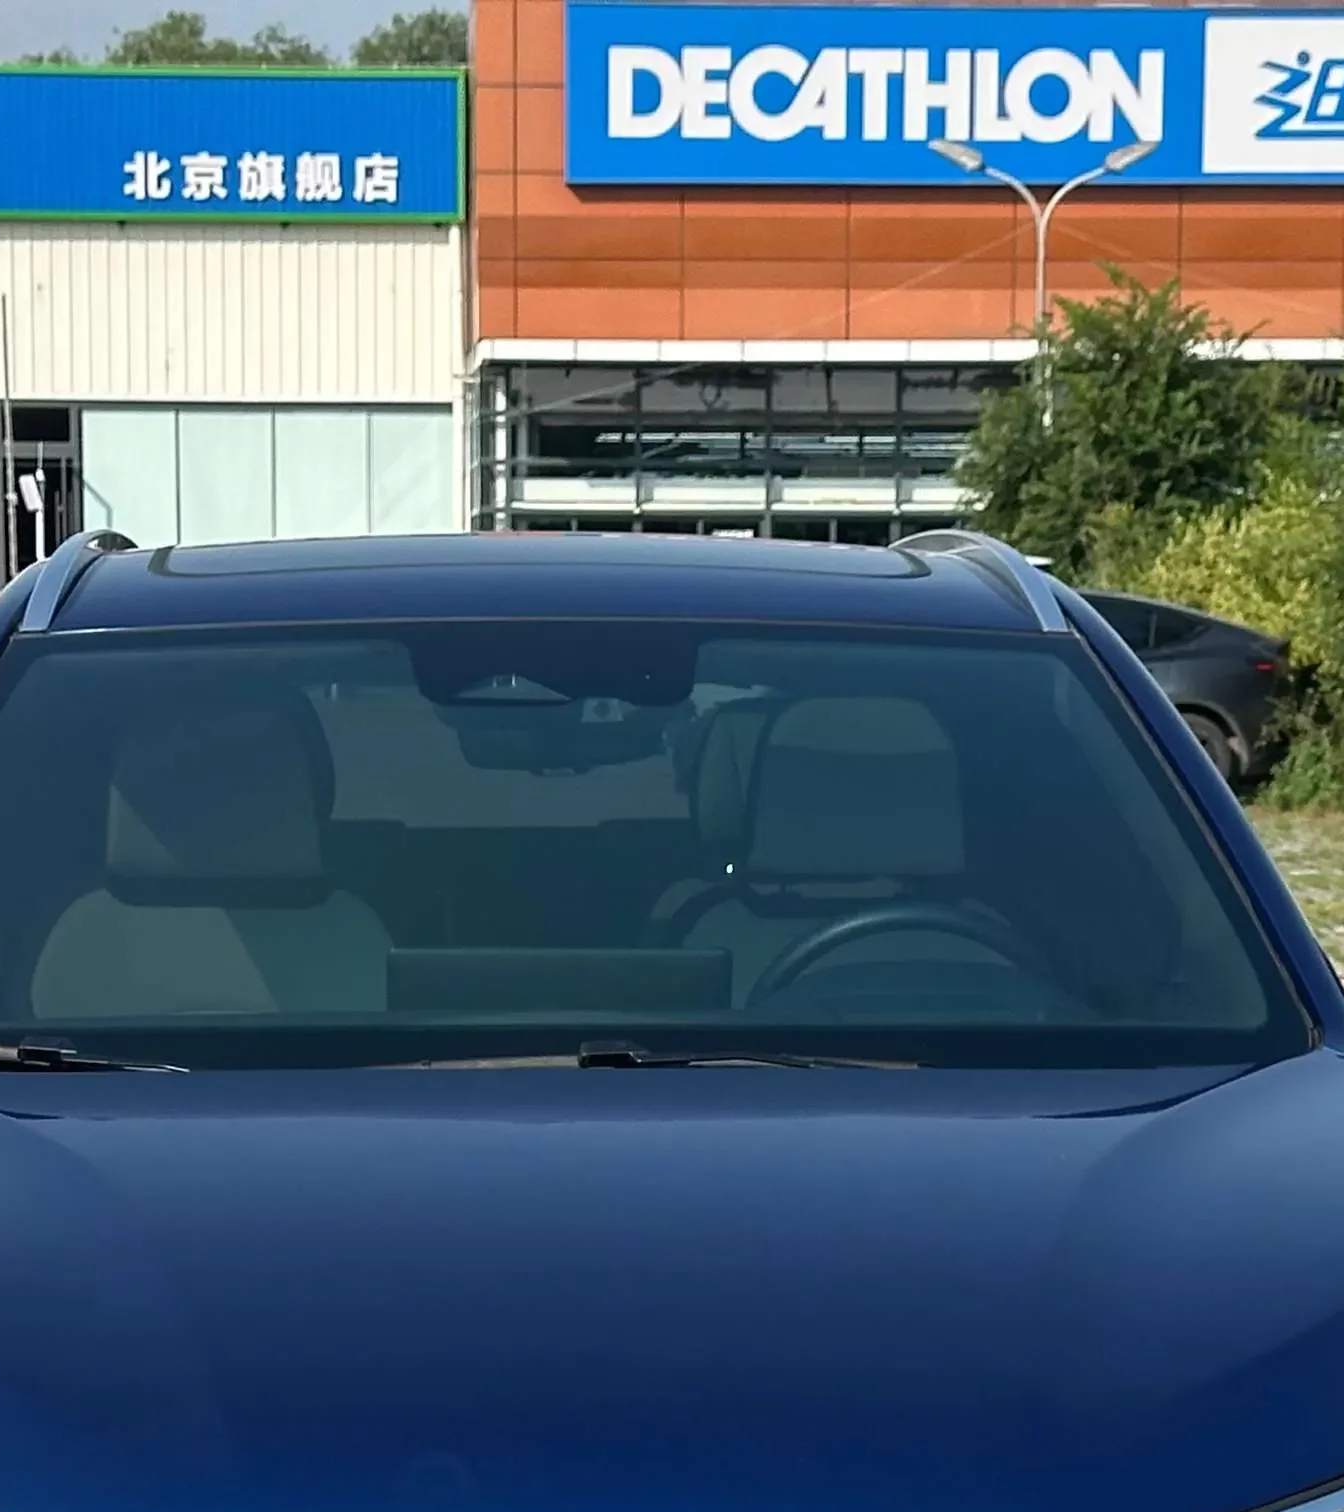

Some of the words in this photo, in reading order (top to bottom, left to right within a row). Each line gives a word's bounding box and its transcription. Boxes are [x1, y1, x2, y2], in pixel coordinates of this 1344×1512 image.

[608, 45, 1164, 144] DECATHLON
[123, 151, 400, 203] 北京旗舰店
